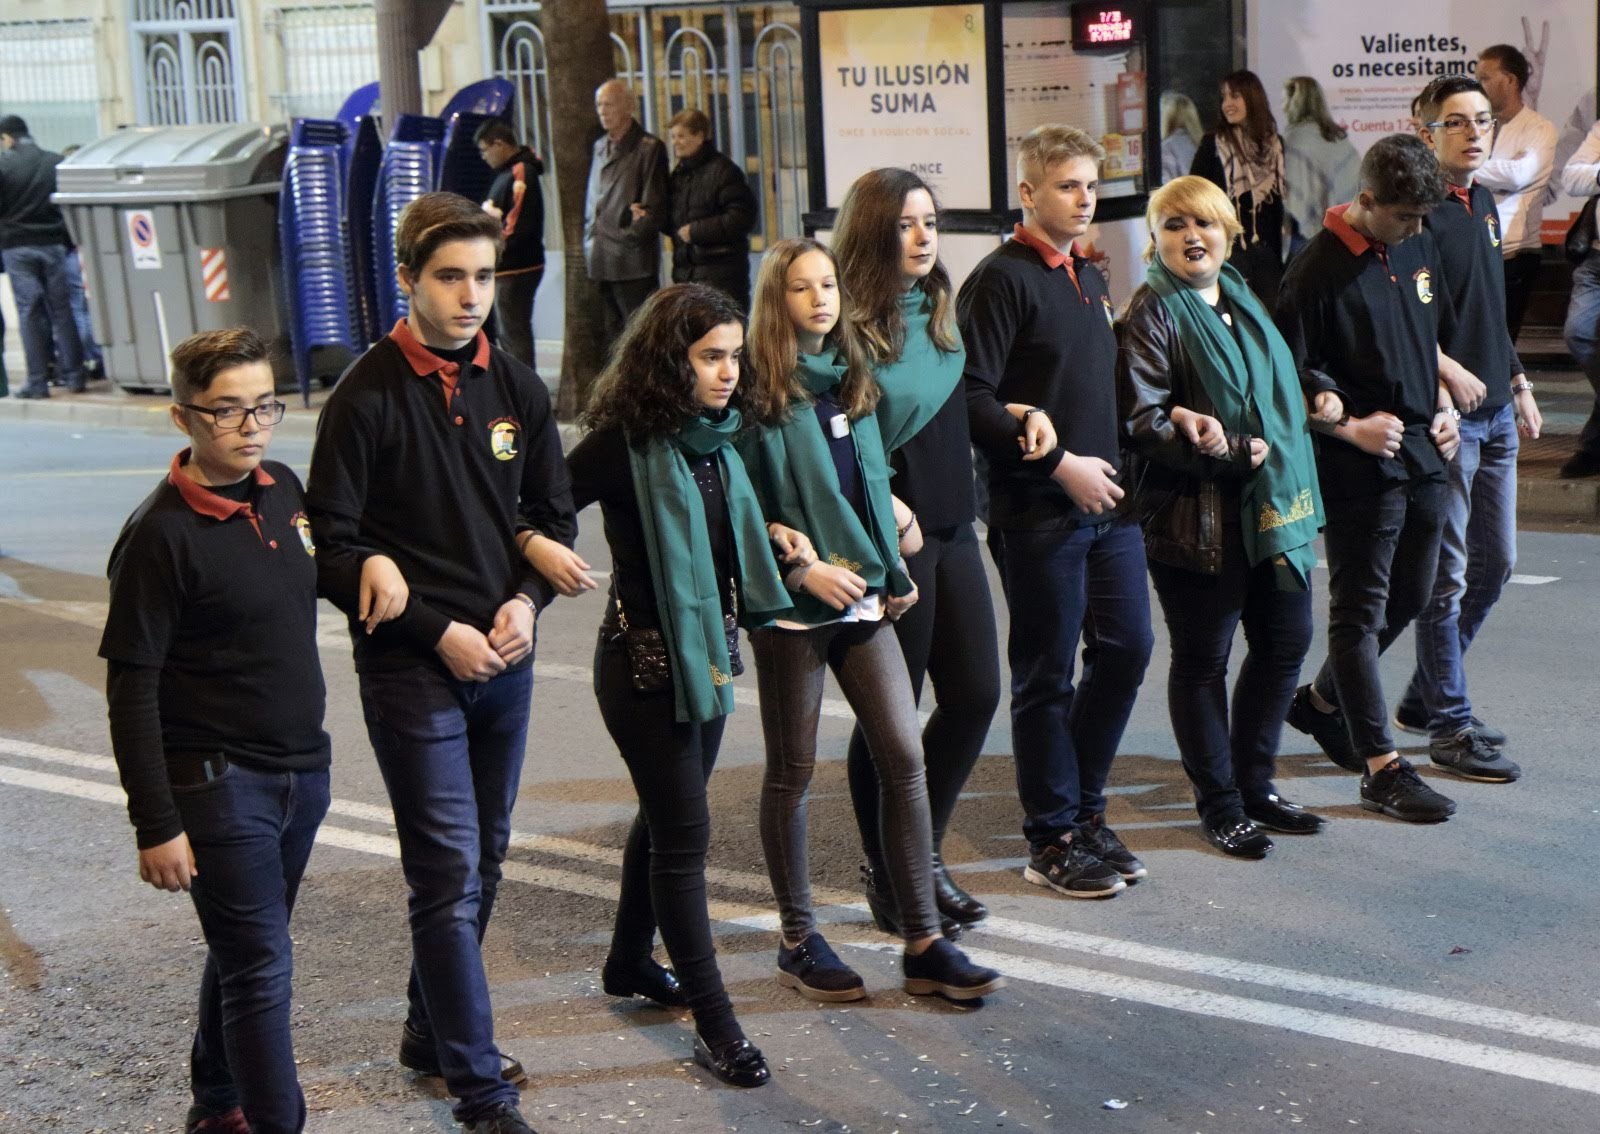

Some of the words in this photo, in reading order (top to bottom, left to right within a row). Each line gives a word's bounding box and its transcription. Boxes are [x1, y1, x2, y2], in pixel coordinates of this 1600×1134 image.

[1361, 33, 1467, 54] Valientes,
[838, 66, 866, 87] TU
[875, 60, 969, 86] ILUSIÓN
[1333, 63, 1354, 77] os
[1359, 56, 1477, 77] necesitamo
[870, 92, 937, 114] SUMA
[1352, 118, 1394, 132] Cuenta
[910, 163, 943, 174] ONCE
